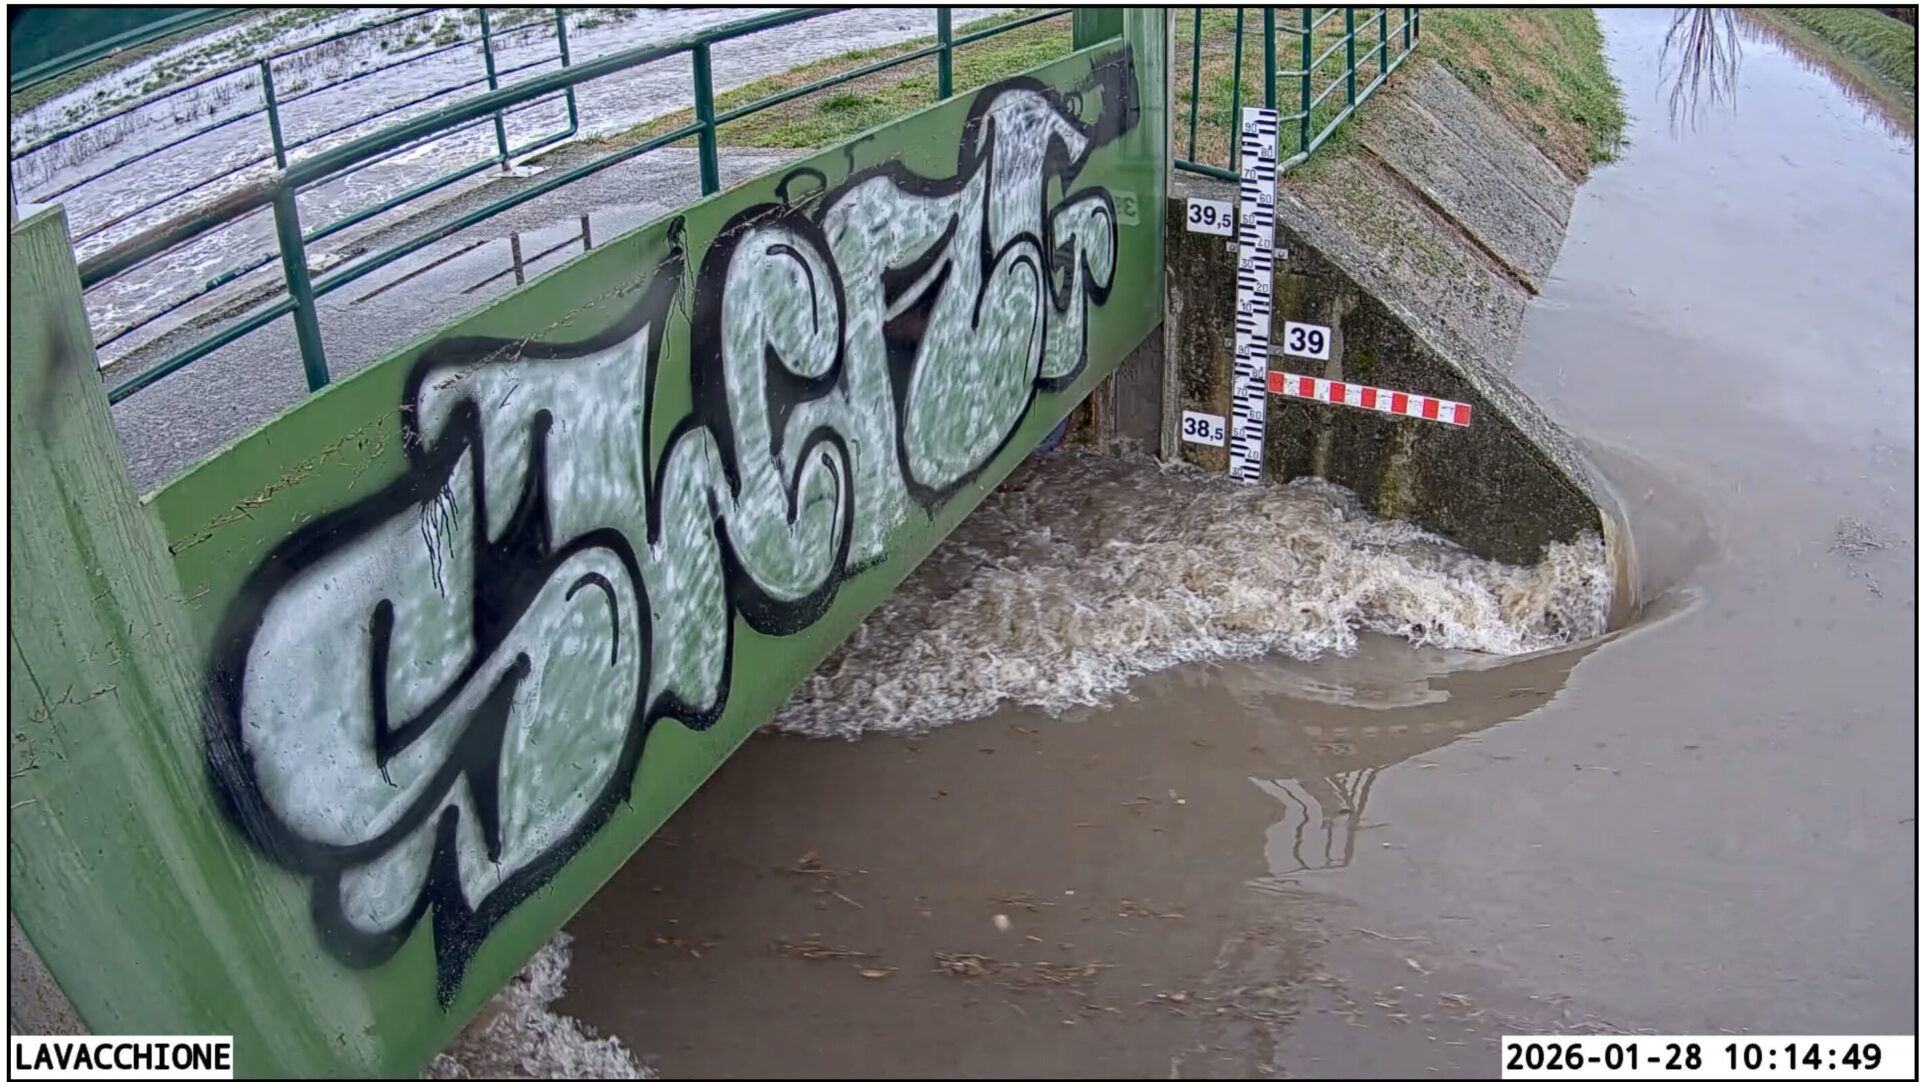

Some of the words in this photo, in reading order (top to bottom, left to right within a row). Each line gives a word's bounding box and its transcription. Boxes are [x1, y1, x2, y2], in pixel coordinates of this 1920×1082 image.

[1245, 122, 1257, 133] 90
[1261, 147, 1273, 158] 80
[1243, 168, 1256, 179] 70
[1260, 193, 1272, 203] 60
[1189, 204, 1231, 229] 39,5
[1242, 214, 1255, 224] 50
[1258, 238, 1270, 248] 40
[1241, 258, 1254, 268] 30
[1256, 282, 1268, 292] 20
[1241, 302, 1252, 312] 10
[1289, 327, 1324, 354] 39
[1237, 387, 1248, 397] 70
[1249, 410, 1261, 419] 60
[1184, 417, 1223, 441] 38,5
[1233, 427, 1246, 437] 50
[1231, 467, 1243, 477] 30
